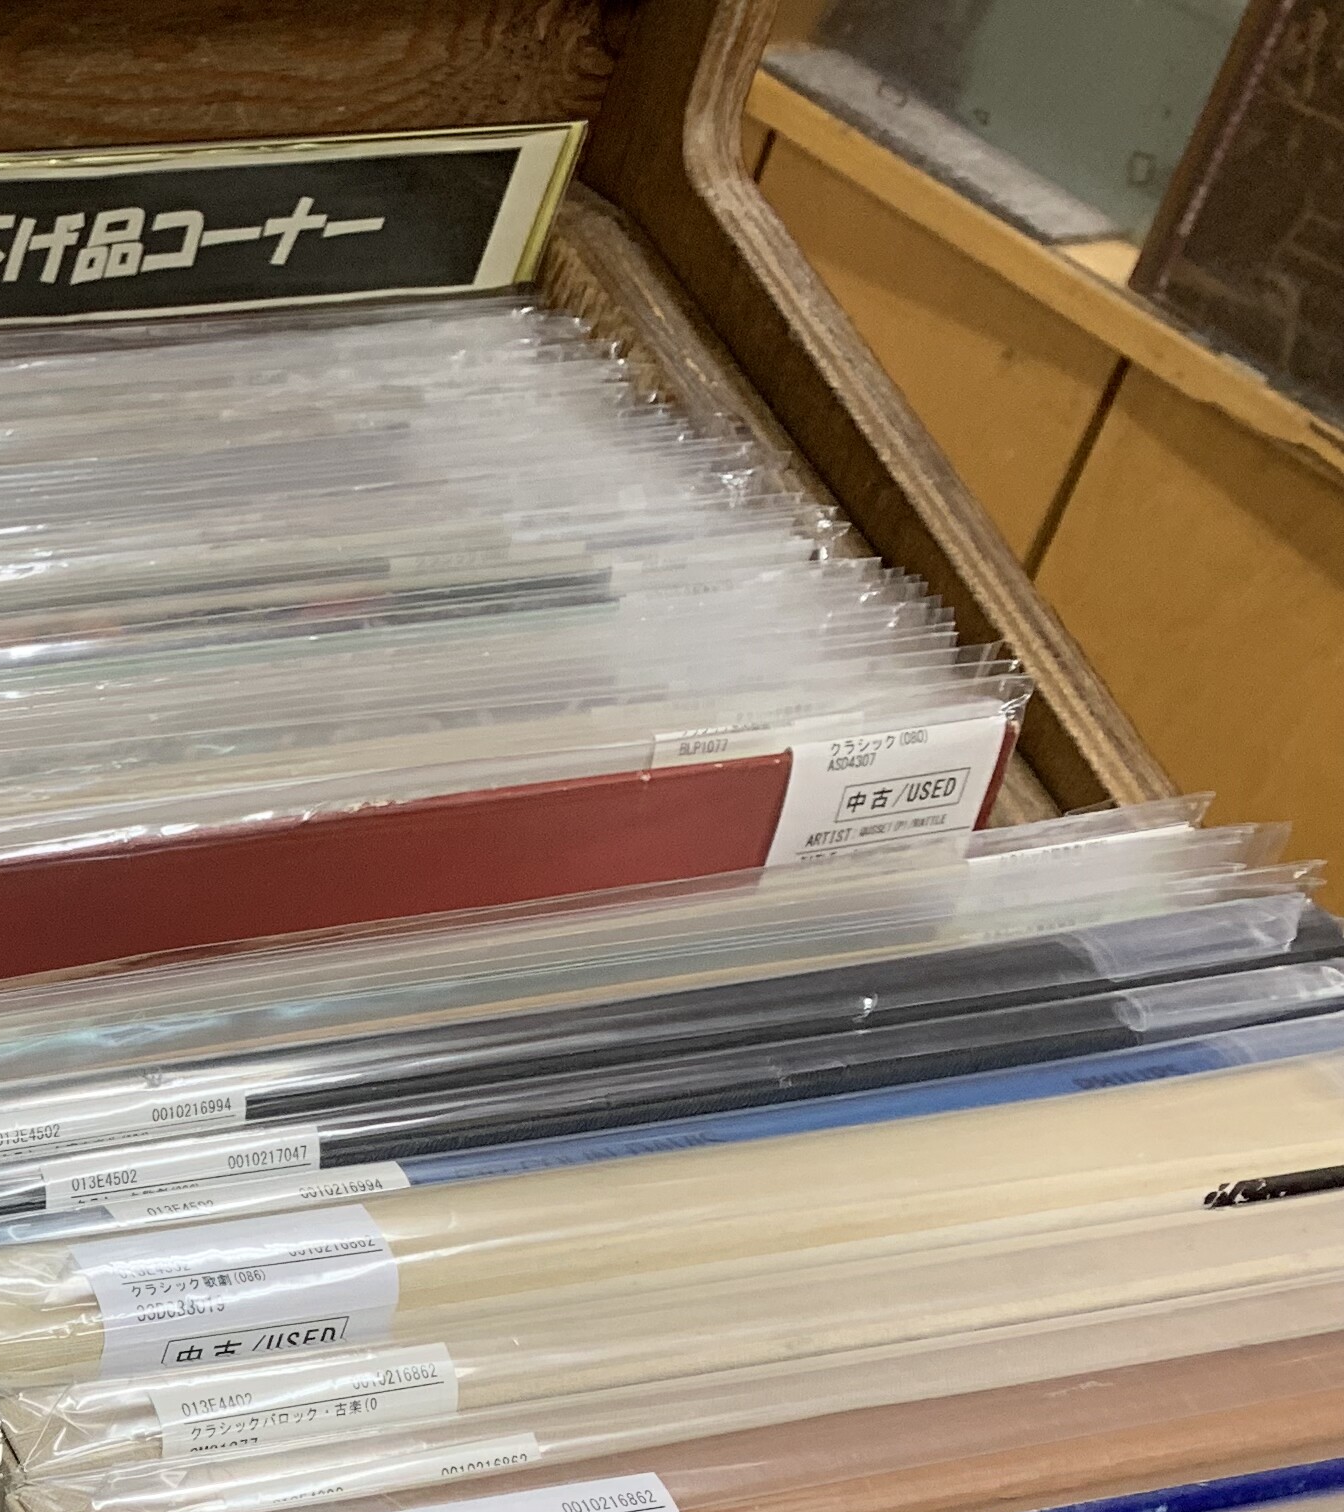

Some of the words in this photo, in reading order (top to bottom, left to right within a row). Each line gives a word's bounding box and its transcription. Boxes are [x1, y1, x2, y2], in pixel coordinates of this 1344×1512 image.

[847, 777, 957, 813] 中古/USED
[151, 1098, 233, 1122] 0010216994
[71, 1168, 138, 1191] 013E4502
[227, 1144, 308, 1170] 0010217047
